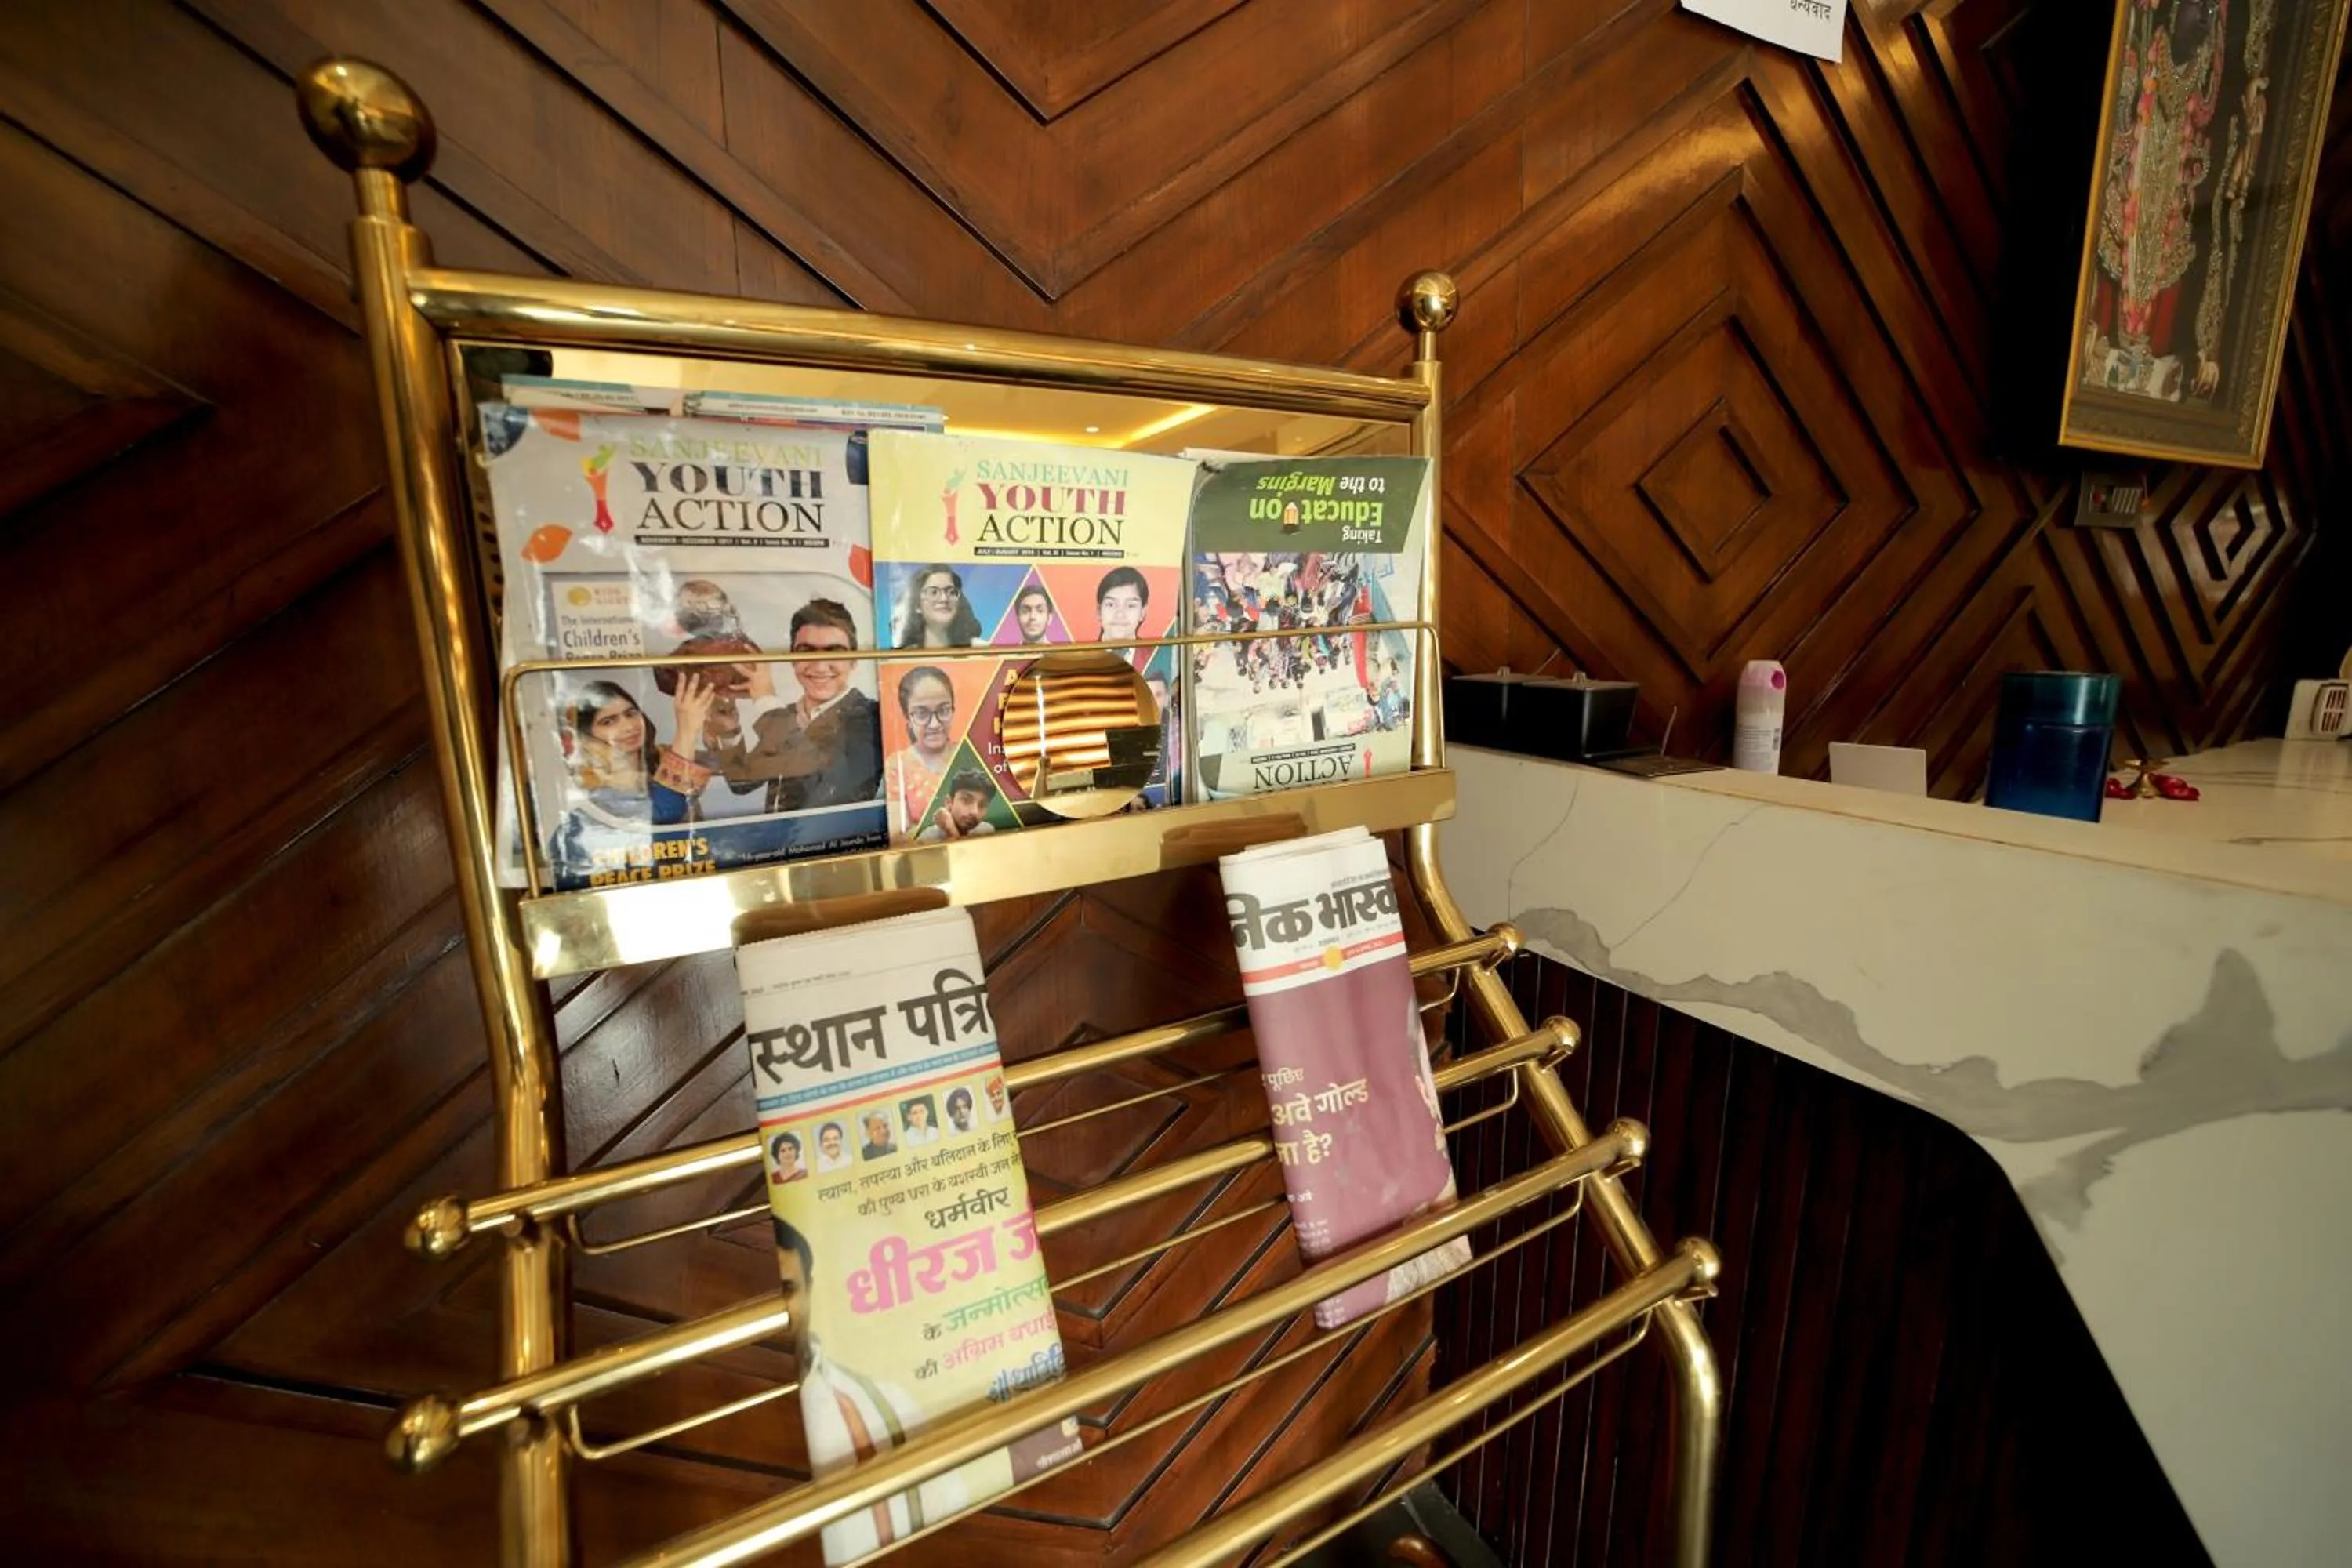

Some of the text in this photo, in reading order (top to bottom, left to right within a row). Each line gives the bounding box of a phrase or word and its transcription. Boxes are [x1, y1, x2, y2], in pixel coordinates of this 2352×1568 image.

[630, 436, 822, 467] SANJEEVANI
[630, 461, 823, 499] YOUTH
[977, 459, 1129, 488] SANJEEVANI
[1256, 471, 1386, 497] to the Margins
[636, 496, 825, 533] ACTION
[975, 482, 1127, 516] YOUTH
[977, 514, 1125, 546] ACTION
[1341, 526, 1384, 546] Taking
[563, 629, 641, 648] Children's
[1254, 753, 1356, 789] ACTION
[1314, 1078, 1370, 1113] गोल्ड
[905, 1155, 929, 1177] और
[858, 1197, 877, 1216] की
[924, 1187, 1011, 1229] धर्मवीर
[846, 1225, 1000, 1315] धीरज
